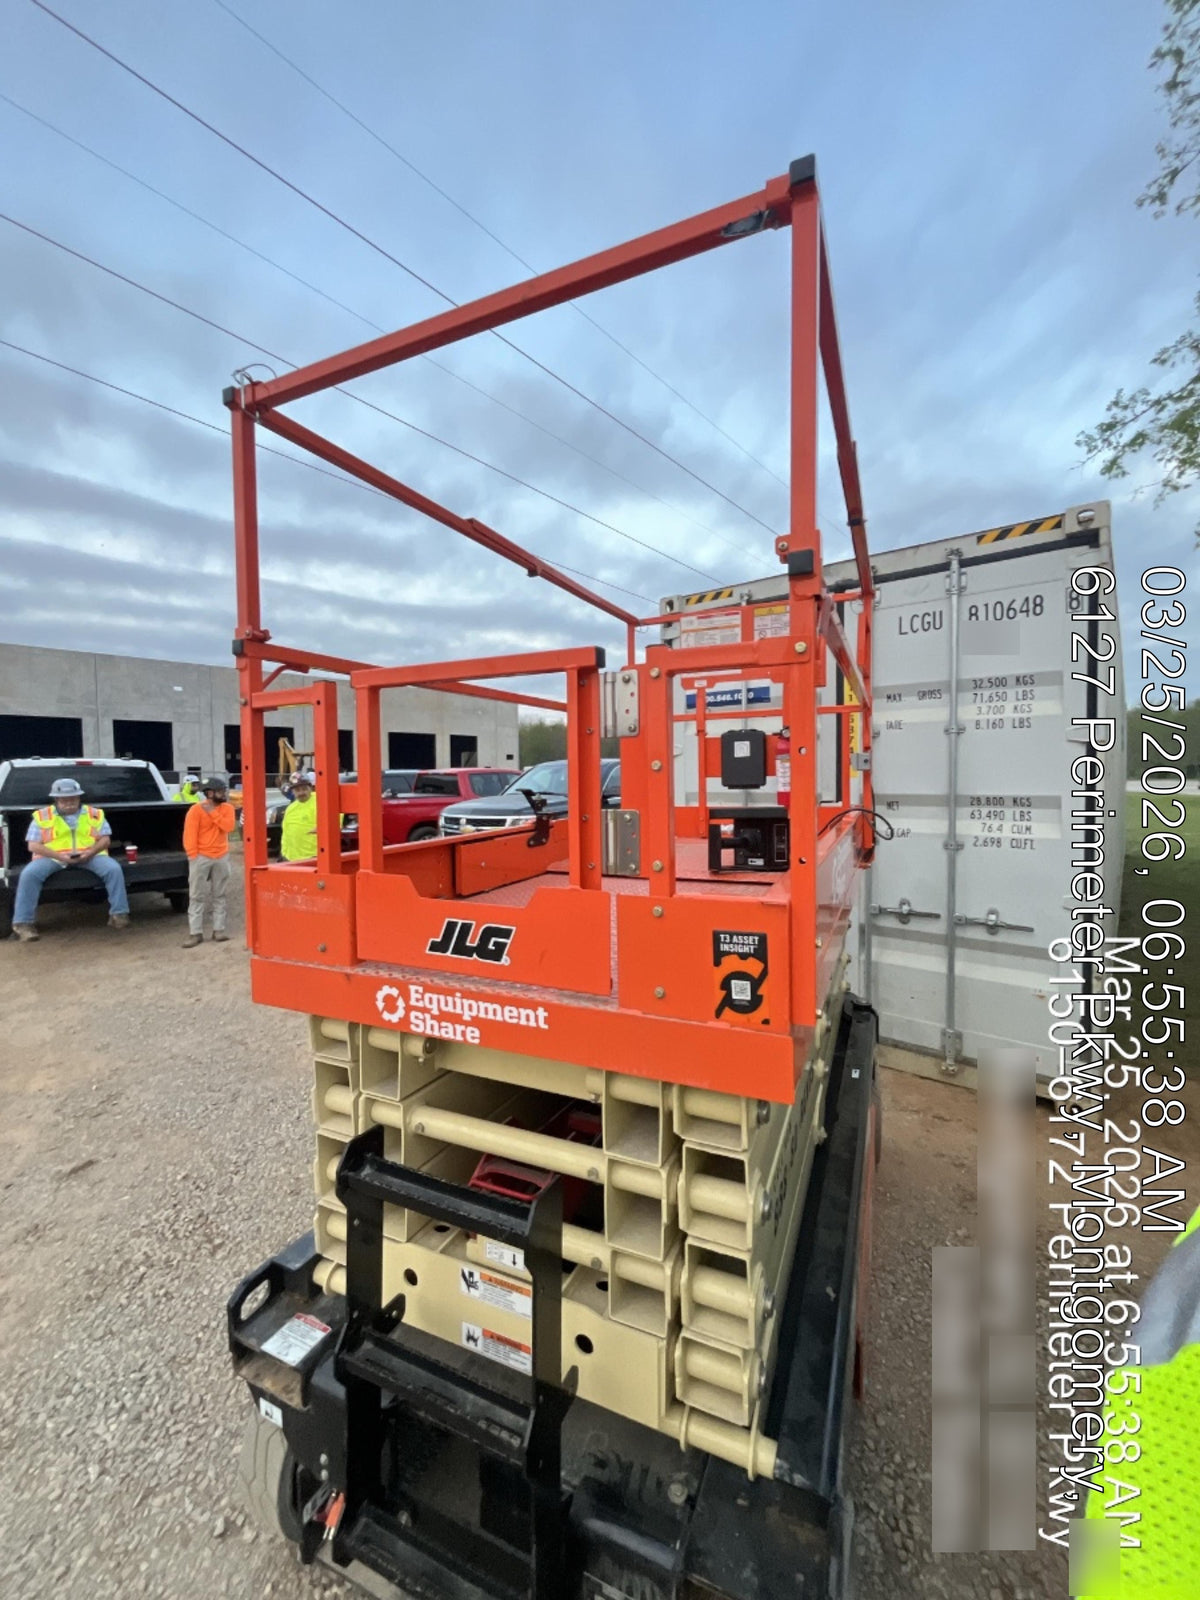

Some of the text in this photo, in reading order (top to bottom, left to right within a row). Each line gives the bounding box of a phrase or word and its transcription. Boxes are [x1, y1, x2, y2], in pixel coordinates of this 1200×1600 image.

[898, 610, 943, 636] LCGU
[972, 674, 1036, 690] 32.500 KGS
[917, 689, 943, 701] GROSS
[972, 689, 1036, 704] 71.650 LBS
[976, 703, 1033, 716] 3.700 KGS
[1011, 717, 1032, 729] LBS
[1012, 796, 1033, 808] KGS
[969, 809, 1032, 822] 63.490 LBS
[426, 918, 516, 965] JLG
[719, 934, 760, 945] T3 ASSET
[408, 984, 549, 1030] Equipment
[409, 1010, 481, 1044] Share
